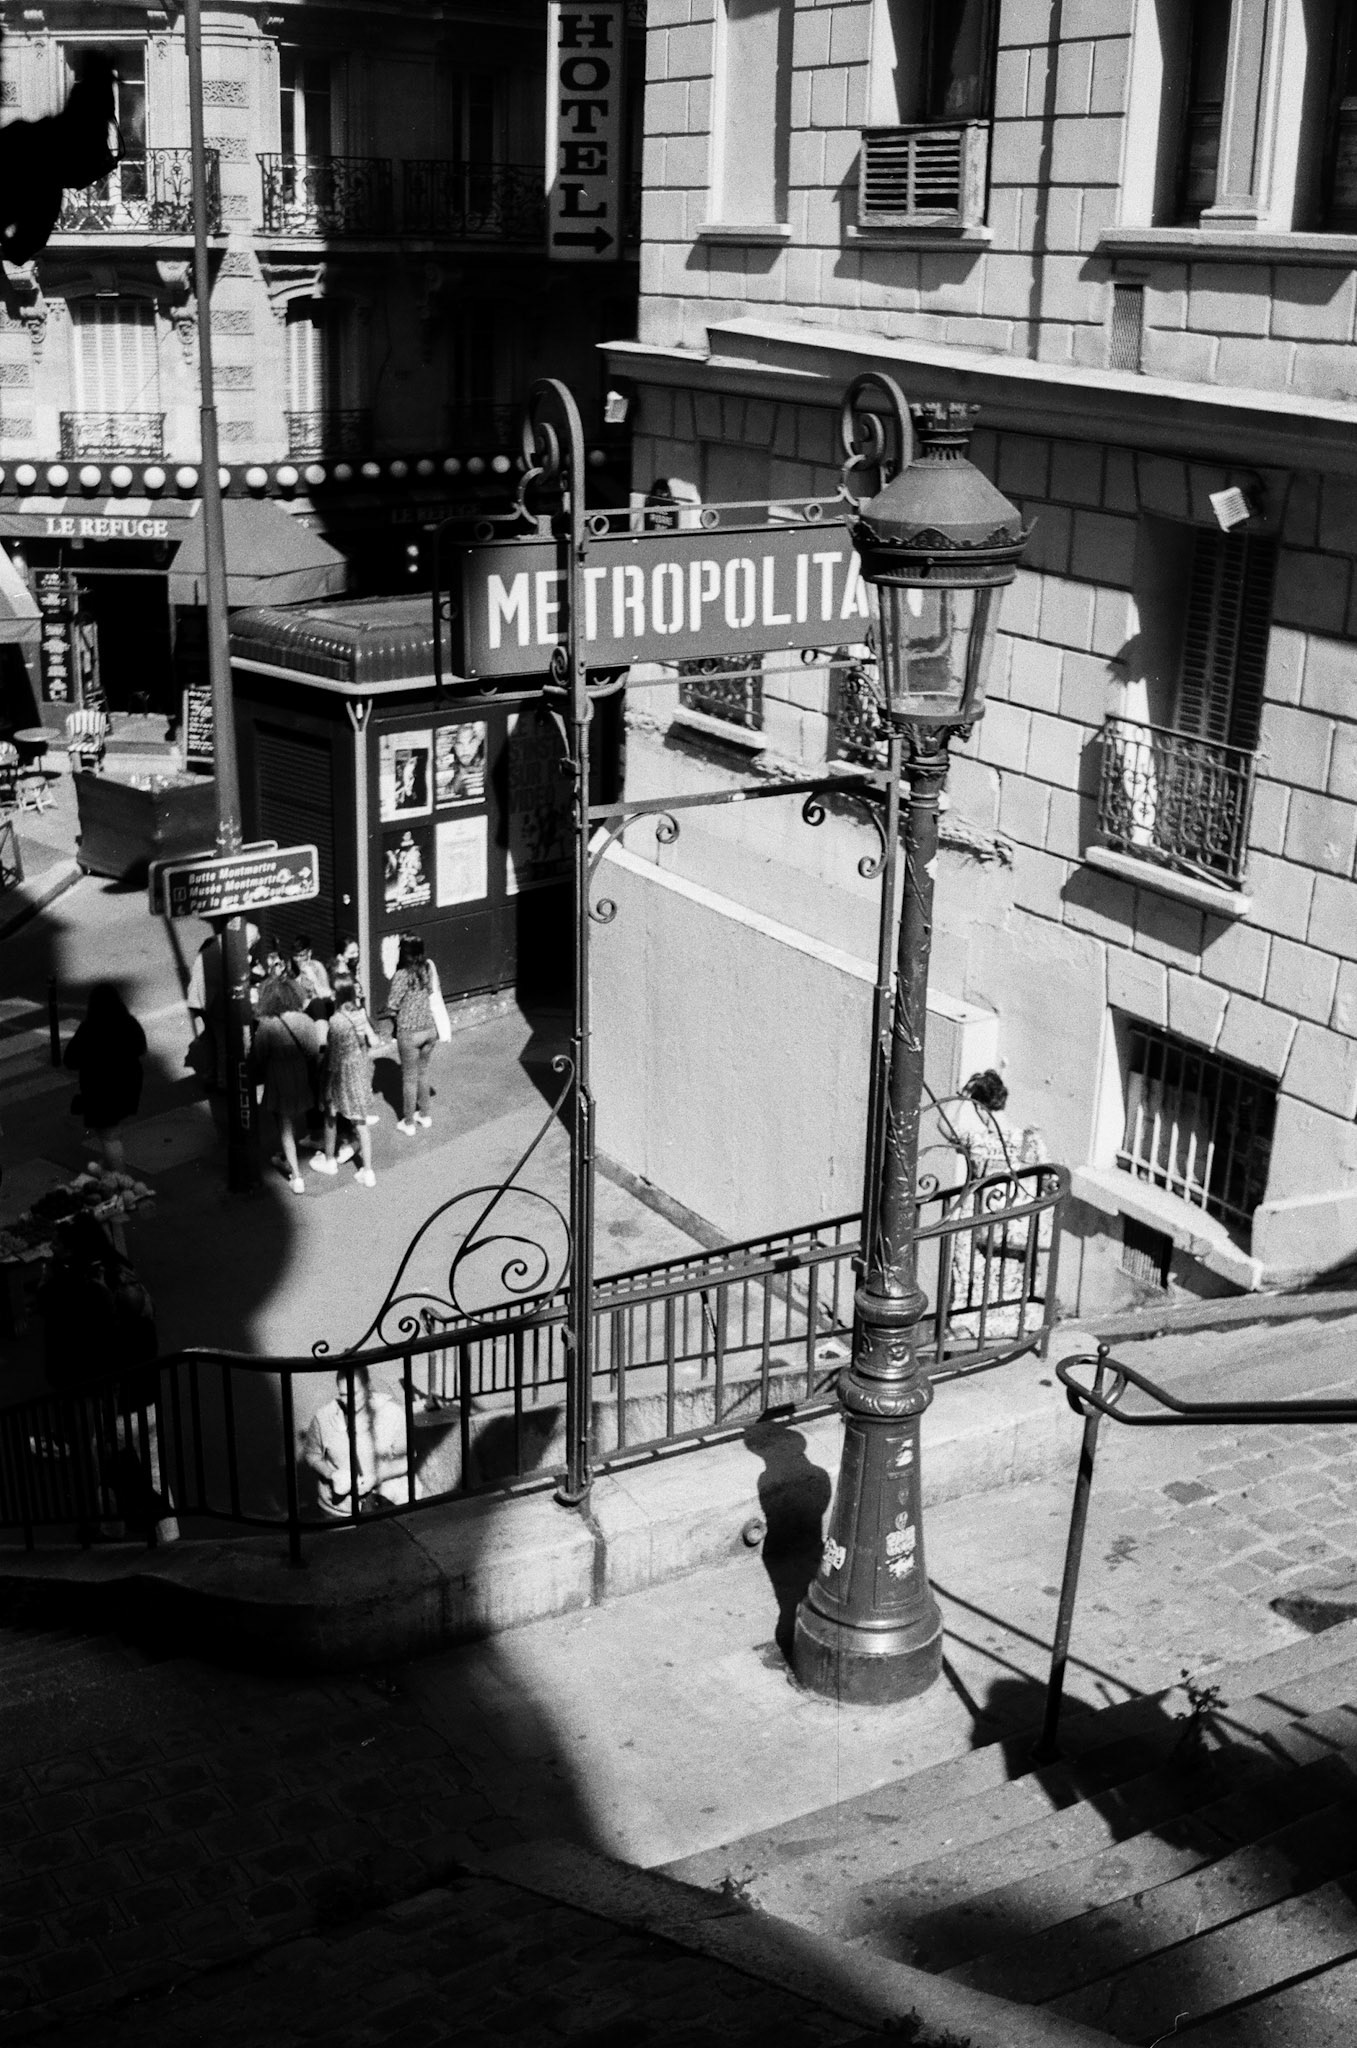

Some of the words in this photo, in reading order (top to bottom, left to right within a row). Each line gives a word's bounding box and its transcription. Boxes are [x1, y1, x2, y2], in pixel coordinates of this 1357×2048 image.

[558, 14, 613, 218] HOTEL
[46, 517, 76, 535] LE
[79, 518, 169, 538] REFUGE
[188, 872, 217, 885] Butte
[219, 862, 277, 879] Montmartre
[189, 882, 222, 898] Musée
[225, 874, 282, 892] Montmartr
